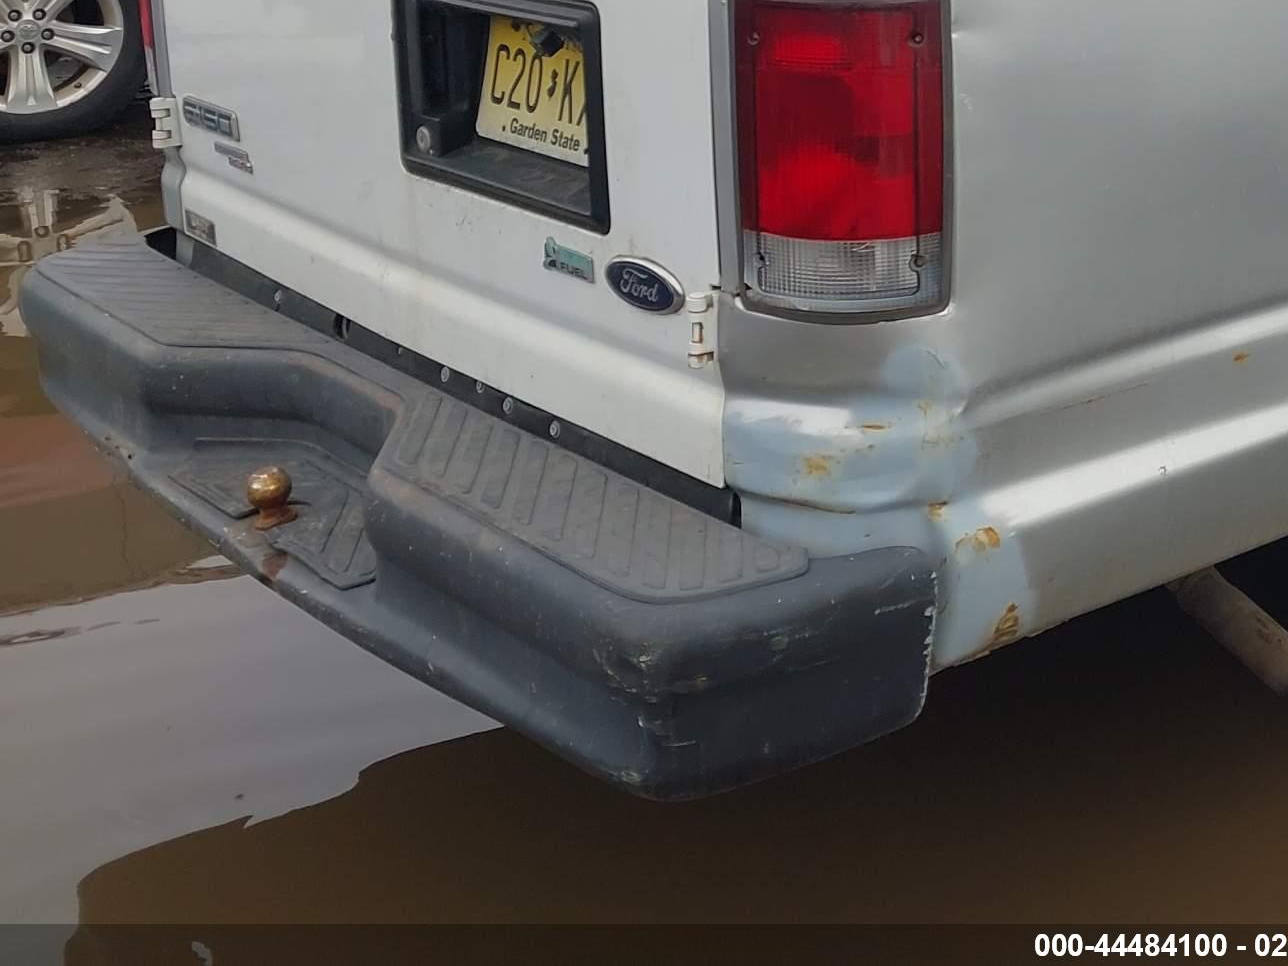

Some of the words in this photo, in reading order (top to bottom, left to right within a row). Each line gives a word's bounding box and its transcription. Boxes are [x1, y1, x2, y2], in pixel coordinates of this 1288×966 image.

[558, 58, 586, 127] K
[510, 117, 547, 143] Garden
[550, 128, 580, 152] State
[620, 268, 659, 302] Ford
